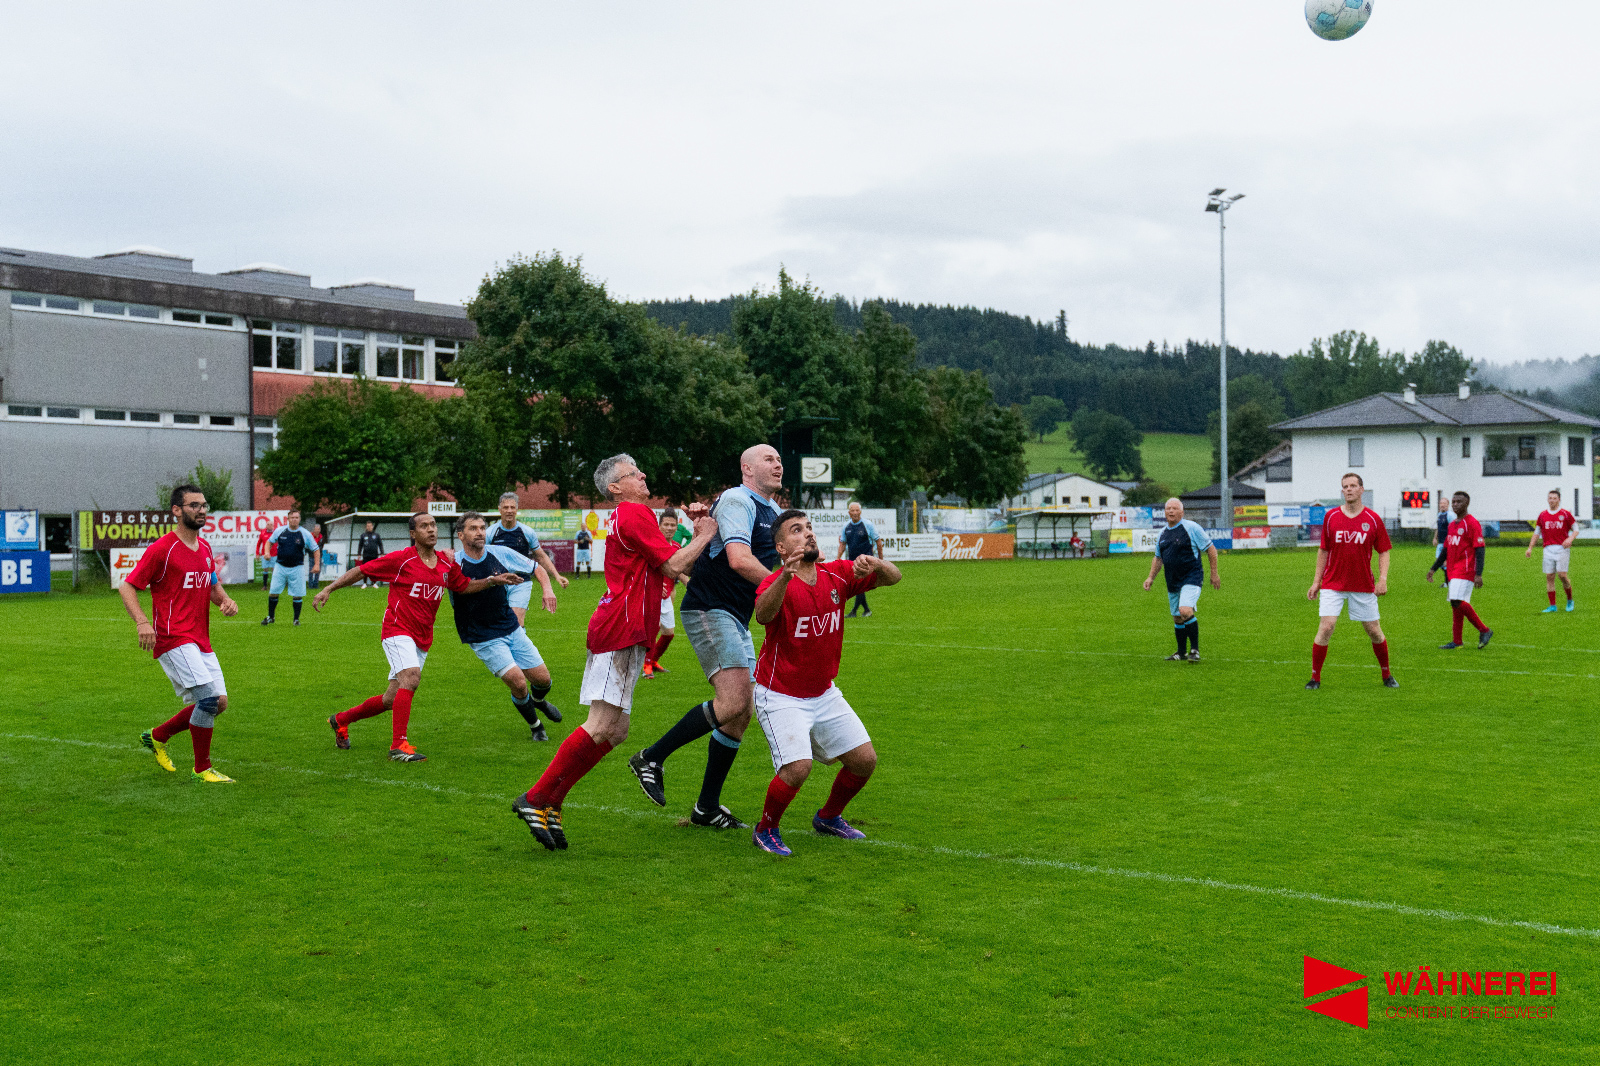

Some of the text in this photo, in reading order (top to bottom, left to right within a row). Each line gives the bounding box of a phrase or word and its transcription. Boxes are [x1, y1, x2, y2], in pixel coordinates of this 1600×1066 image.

[201, 511, 288, 533] SCHÖN
[810, 513, 850, 522] Feldbache
[1335, 530, 1367, 544] EVN
[1, 559, 33, 586] BE
[794, 609, 840, 637] EVN
